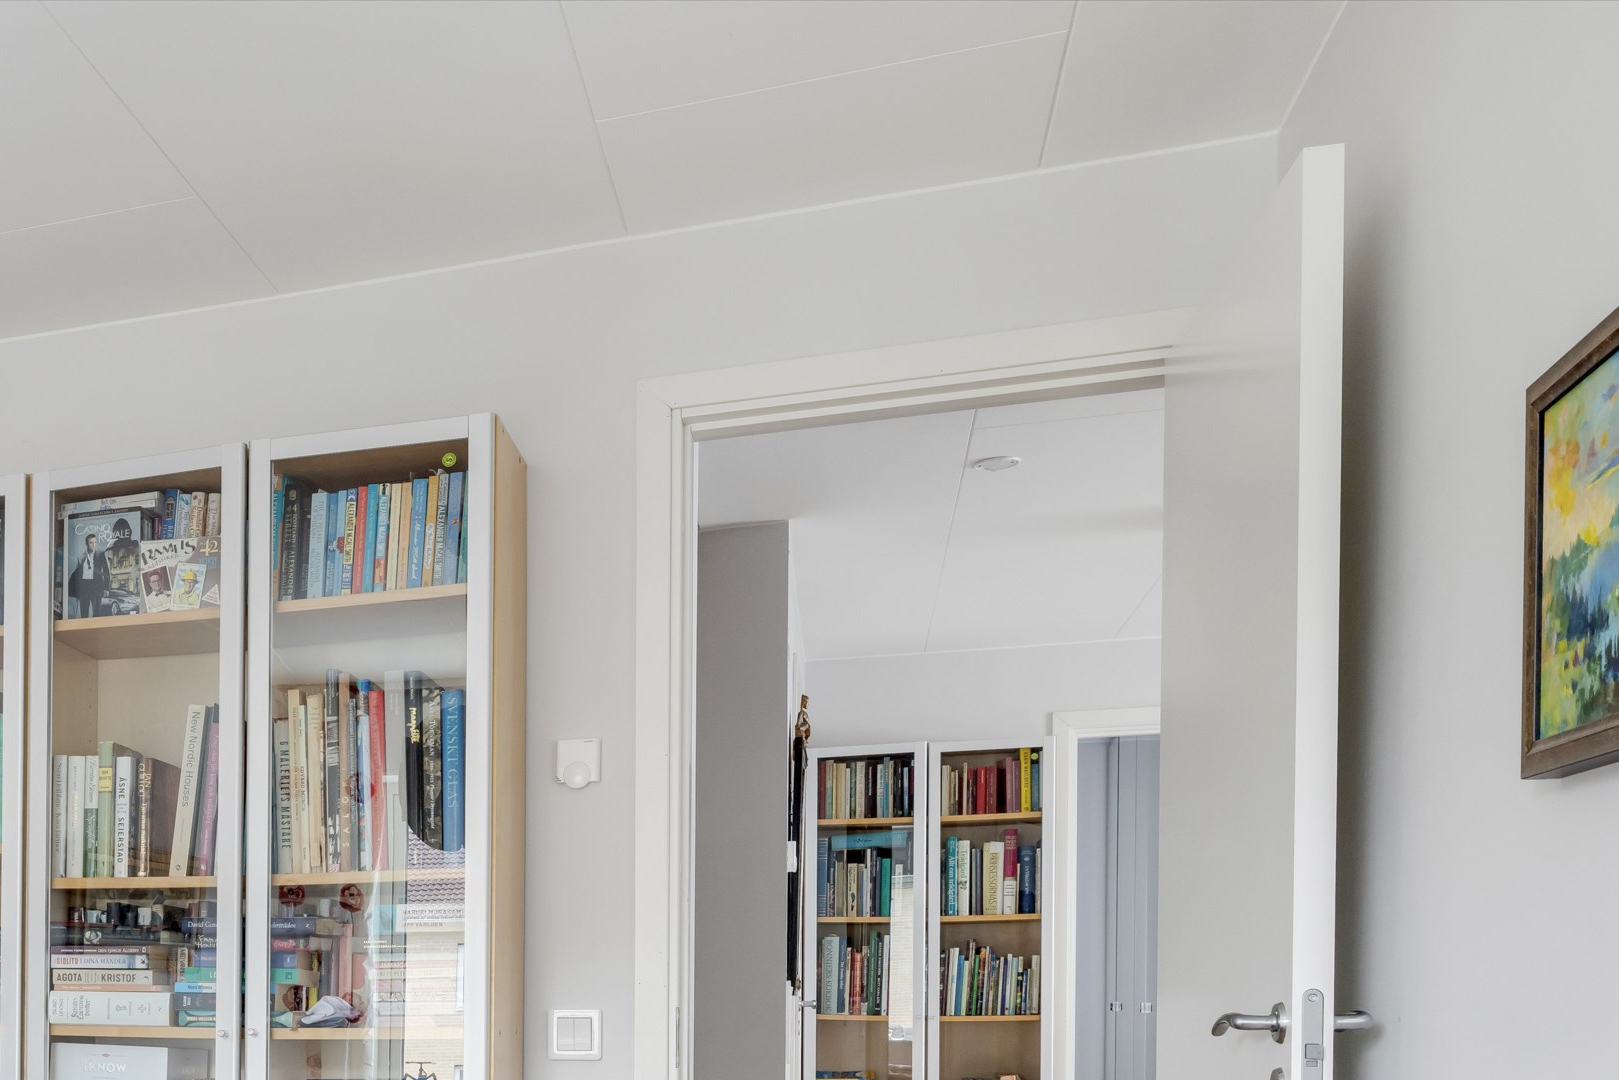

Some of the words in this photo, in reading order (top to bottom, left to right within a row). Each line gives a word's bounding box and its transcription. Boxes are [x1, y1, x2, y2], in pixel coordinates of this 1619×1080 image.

[346, 503, 356, 531] ALEXANDER
[378, 496, 387, 526] ALEXANDER
[437, 506, 446, 542] ALEXANDER
[75, 523, 111, 536] CASINO
[98, 528, 130, 544] ROYALE
[199, 538, 219, 556] 42
[344, 549, 353, 563] SMITH
[287, 550, 295, 594] ALEXANDER
[190, 711, 200, 734] New
[446, 696, 459, 766] SVENSKT
[185, 736, 198, 768] Nordic
[118, 777, 127, 799] ÅSNE
[181, 771, 194, 807] Houses
[447, 769, 459, 808] GLAS
[117, 817, 125, 863] SEIERSTAD
[945, 878, 955, 905] trädgård
[988, 852, 999, 905] PRINSESSORNAS
[826, 939, 834, 978] BONNIERS
[56, 973, 82, 982] AGOTA
[101, 974, 136, 983] KRISTOF
[825, 980, 833, 1011] KOKBOK
